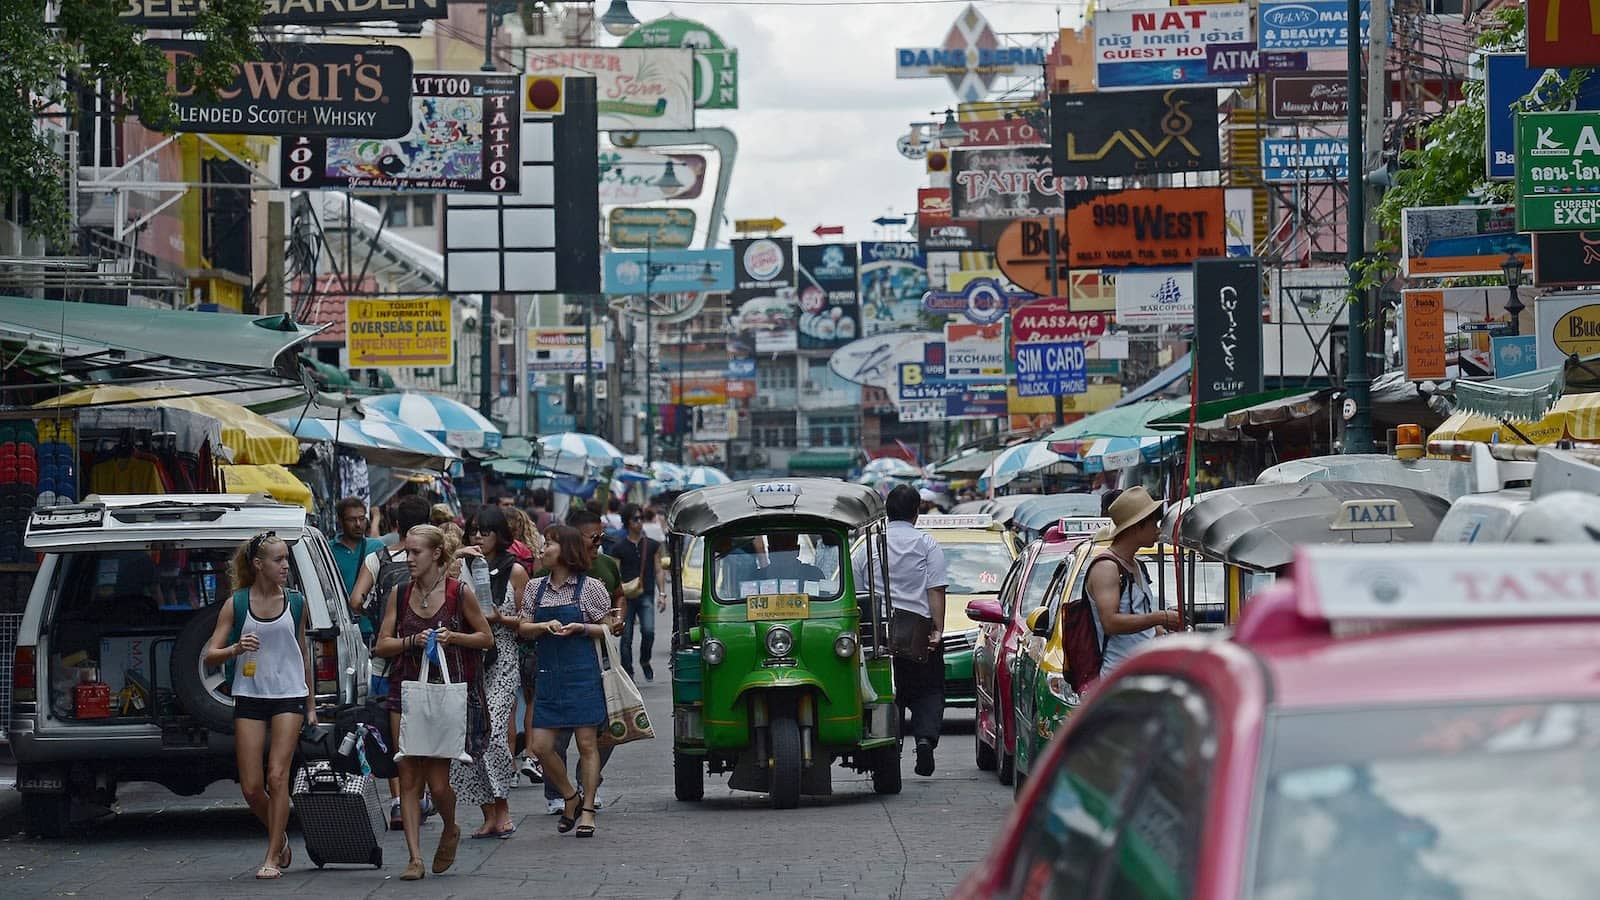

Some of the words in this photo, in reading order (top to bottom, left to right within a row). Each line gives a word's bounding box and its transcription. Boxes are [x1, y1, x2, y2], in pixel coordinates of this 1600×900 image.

[118, 0, 208, 17] BEE
[1132, 11, 1207, 32] NAT
[1266, 29, 1276, 39] &
[1280, 28, 1336, 39] BEAUTY
[1103, 47, 1167, 60] GUEST
[1177, 46, 1204, 57] HO
[1212, 50, 1260, 70] ATM
[530, 52, 622, 72] CENTER
[1281, 101, 1311, 113] Massage
[1322, 101, 1339, 113] Body
[247, 105, 308, 125] SCOTCH
[313, 106, 377, 127] WHISKY
[489, 95, 510, 191] TATTOO
[1573, 125, 1600, 156] A
[1268, 143, 1307, 155] THAI
[1270, 156, 1280, 167] &
[1495, 151, 1516, 165] Ba
[1093, 203, 1129, 227] 999
[1133, 204, 1208, 241] WEST
[390, 301, 429, 309] TOURIST
[376, 309, 442, 318] INFORMATION
[351, 321, 413, 334] OVERSEAS
[416, 320, 447, 333] CALL
[352, 337, 413, 350] INTERNET
[1017, 349, 1042, 374] SIM
[1046, 346, 1085, 371] CARD
[1019, 381, 1049, 396] UNLOCK
[1212, 381, 1245, 391] CLIFF
[758, 484, 792, 493] TAXI
[1347, 504, 1397, 523] TAXI
